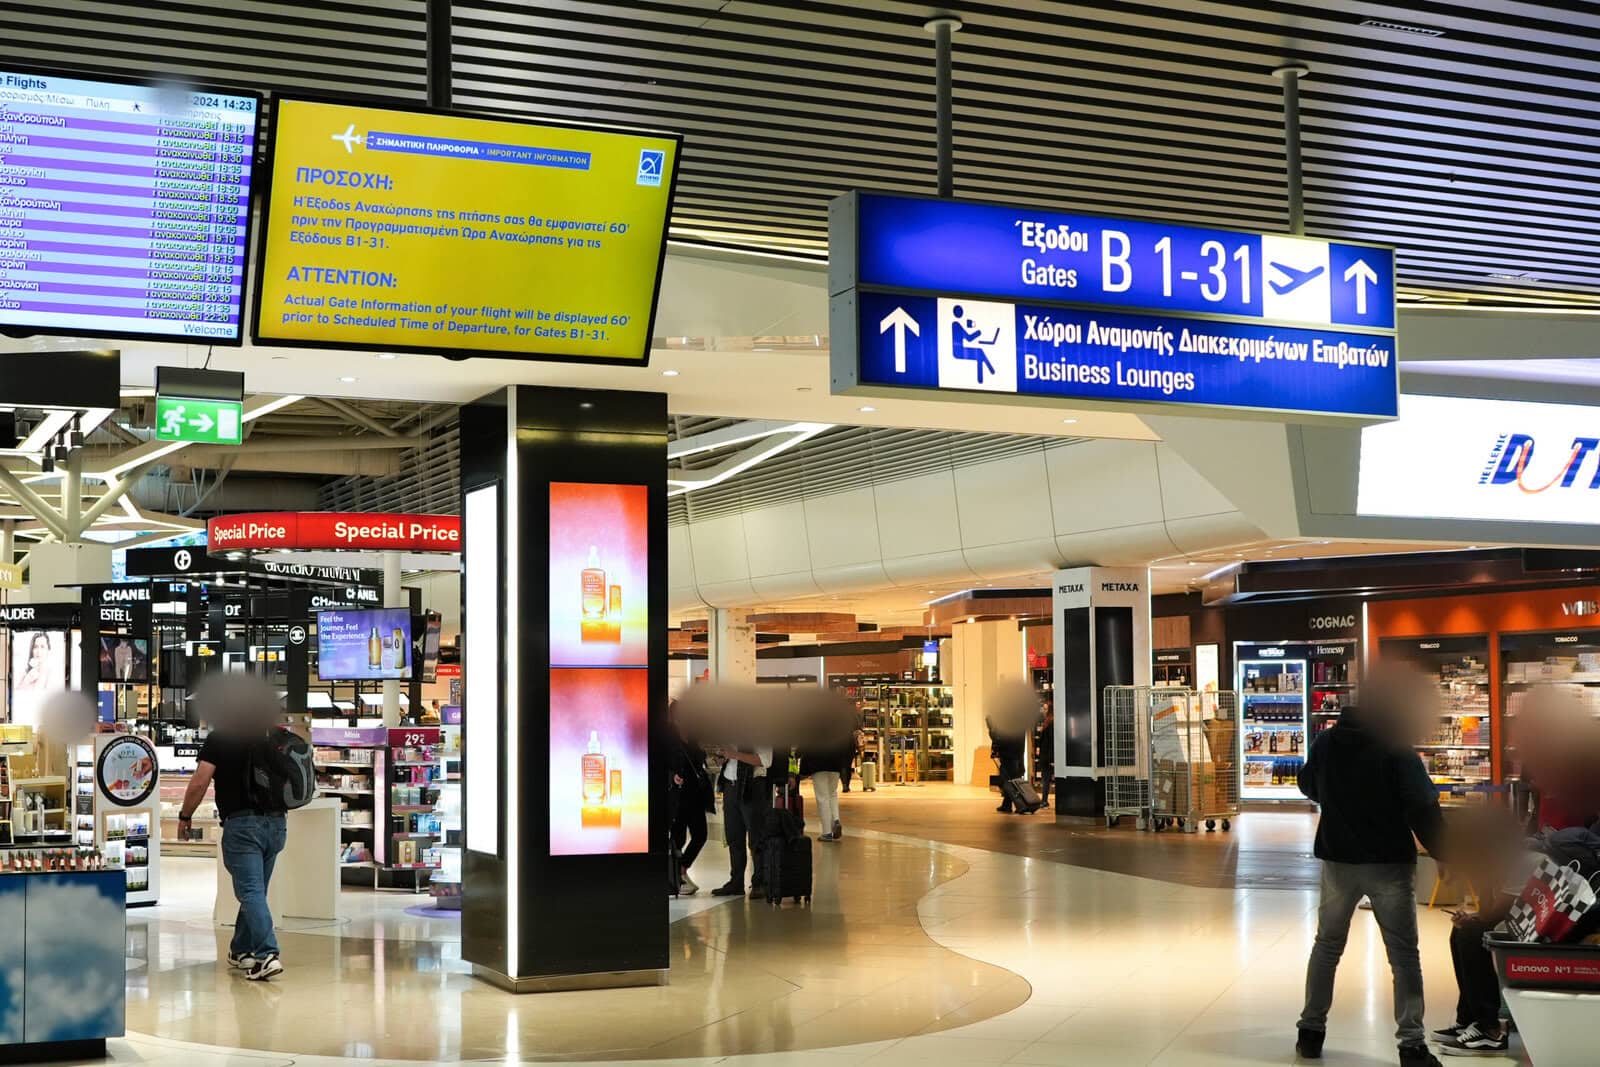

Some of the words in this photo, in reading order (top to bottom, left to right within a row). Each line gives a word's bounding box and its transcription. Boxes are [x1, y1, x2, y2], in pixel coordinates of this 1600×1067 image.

[7, 76, 47, 89] Flights
[193, 96, 218, 108] 2024
[223, 99, 252, 110] 14:23
[220, 133, 244, 143] 18:15
[376, 138, 424, 150] ΣΗΜΑΝΤΙΚΗ
[426, 144, 479, 155] ΠΛΗΡΟΦΟΡΙΑ
[487, 149, 532, 160] IMPORTANT
[534, 154, 587, 165] INFORMATION
[216, 173, 240, 183] 18:45
[296, 167, 394, 190] ΠΡΟΣΟΧΗ:
[214, 214, 236, 224] 19:05
[304, 196, 350, 210] Έξοδος
[354, 201, 432, 218] Αναχώρησης
[437, 210, 455, 220] της
[459, 210, 500, 224] πτήσης
[504, 215, 525, 225] σας
[529, 216, 543, 227] θα
[546, 219, 607, 232] εμφανιστεί
[290, 231, 342, 246] Εξόδους
[292, 215, 318, 227] πριν
[322, 218, 342, 227] την
[346, 218, 458, 238] Προγραμματισμένη
[462, 226, 486, 240] Ώρα
[489, 230, 563, 246] Αναχώρησης
[567, 236, 583, 248] για
[587, 238, 601, 248] τις
[1015, 220, 1088, 253] Έξοδοι
[211, 253, 233, 263] 19:15
[1101, 229, 1132, 292] B
[1154, 237, 1250, 304] 1-31
[286, 266, 397, 288] ATTENTION:
[1021, 259, 1077, 288] Gates
[284, 294, 324, 306] Actual
[329, 297, 357, 308] Gate
[361, 298, 432, 313] Information
[435, 304, 448, 314] of
[451, 306, 478, 316] your
[481, 306, 512, 320] flight
[515, 310, 534, 320] will
[538, 311, 550, 321] be
[554, 313, 608, 325] displayed
[184, 324, 232, 336] Welcome
[282, 312, 313, 324] prior
[317, 313, 329, 324] to
[334, 314, 396, 328] Scheduled
[400, 318, 429, 330] Time
[432, 320, 445, 331] of
[514, 326, 531, 335] for
[534, 327, 566, 338] Gates
[570, 329, 610, 341] B1-31.
[1024, 315, 1081, 347] Χώροι
[1087, 320, 1174, 356] Αναμονής
[1179, 328, 1308, 363] Διακεκριμένων
[1312, 339, 1389, 369] Επιβατών
[1024, 354, 1110, 385] Business
[1116, 361, 1195, 395] Lounges
[1478, 432, 1509, 484] HELLENIC
[214, 524, 246, 544] Special
[249, 523, 286, 539] Price
[335, 522, 405, 542] Special
[410, 524, 459, 541] Price
[103, 589, 150, 600] CHANEL
[1059, 584, 1084, 593] METAXA
[1102, 583, 1138, 591] METAXA
[1309, 615, 1355, 629] COGNAC
[1317, 646, 1345, 655] Hennessy
[1511, 964, 1550, 973] Lenovo
